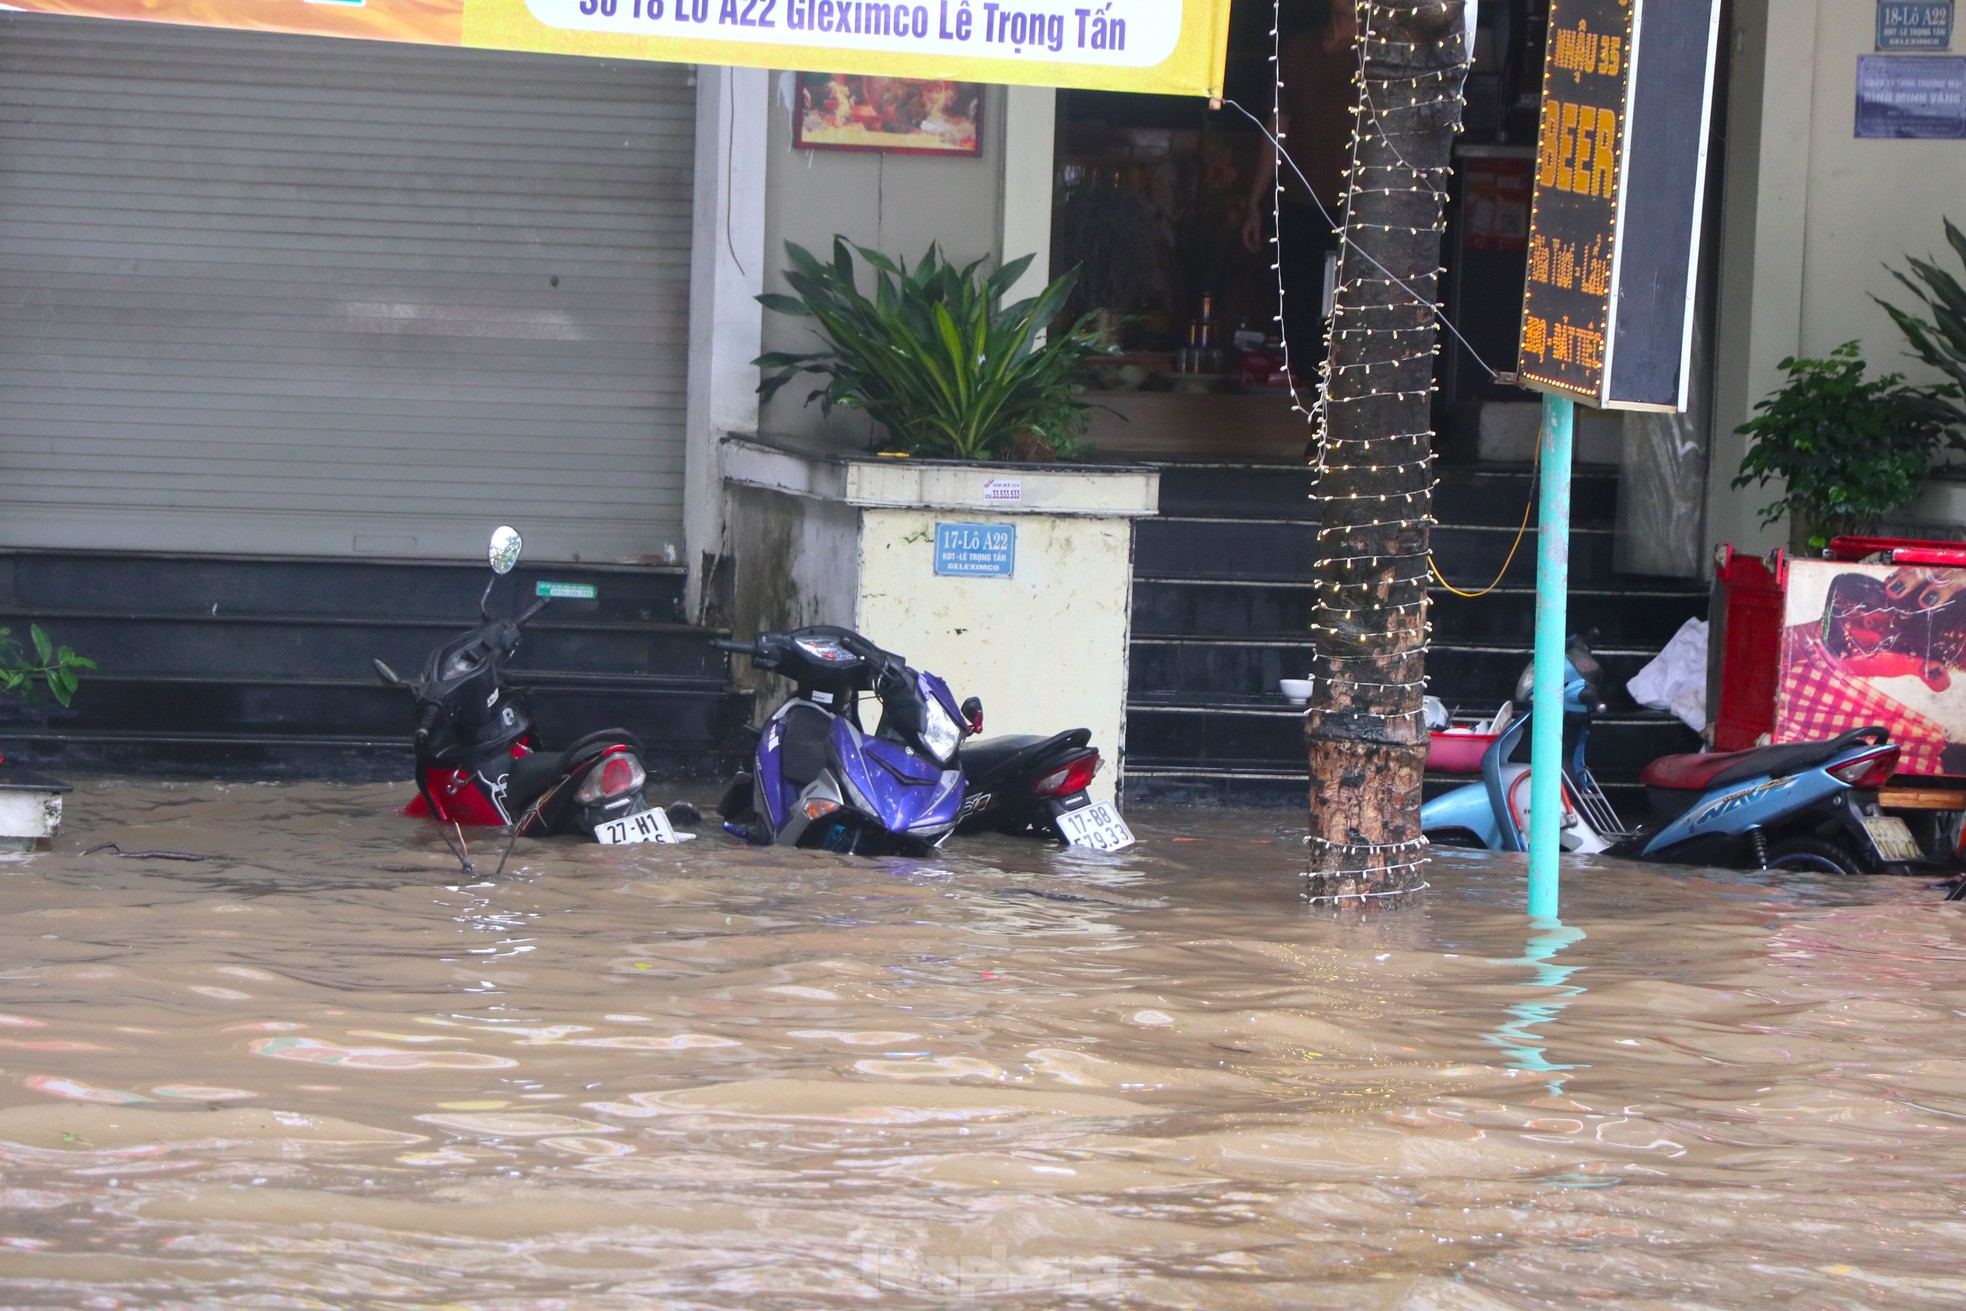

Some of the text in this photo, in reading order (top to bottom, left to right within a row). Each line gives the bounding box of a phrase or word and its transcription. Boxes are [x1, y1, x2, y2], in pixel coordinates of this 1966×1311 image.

[718, 0, 776, 28] A22
[787, 0, 929, 39] Gleximco
[939, 0, 972, 41] Lê
[983, 2, 1064, 54] Trọng
[1074, 2, 1126, 51] Tấn
[1885, 6, 1947, 26] 18-Lô A22
[1554, 18, 1621, 84] NHẬU 35
[1540, 100, 1616, 199] BEER
[943, 530, 1008, 551] 17-Lô A22
[947, 562, 1000, 571] GELEXIMCO
[969, 552, 991, 563] TRỌNG
[604, 798, 631, 811] HONDA
[606, 813, 659, 844] 27-H1
[1068, 806, 1112, 834] 17-B8
